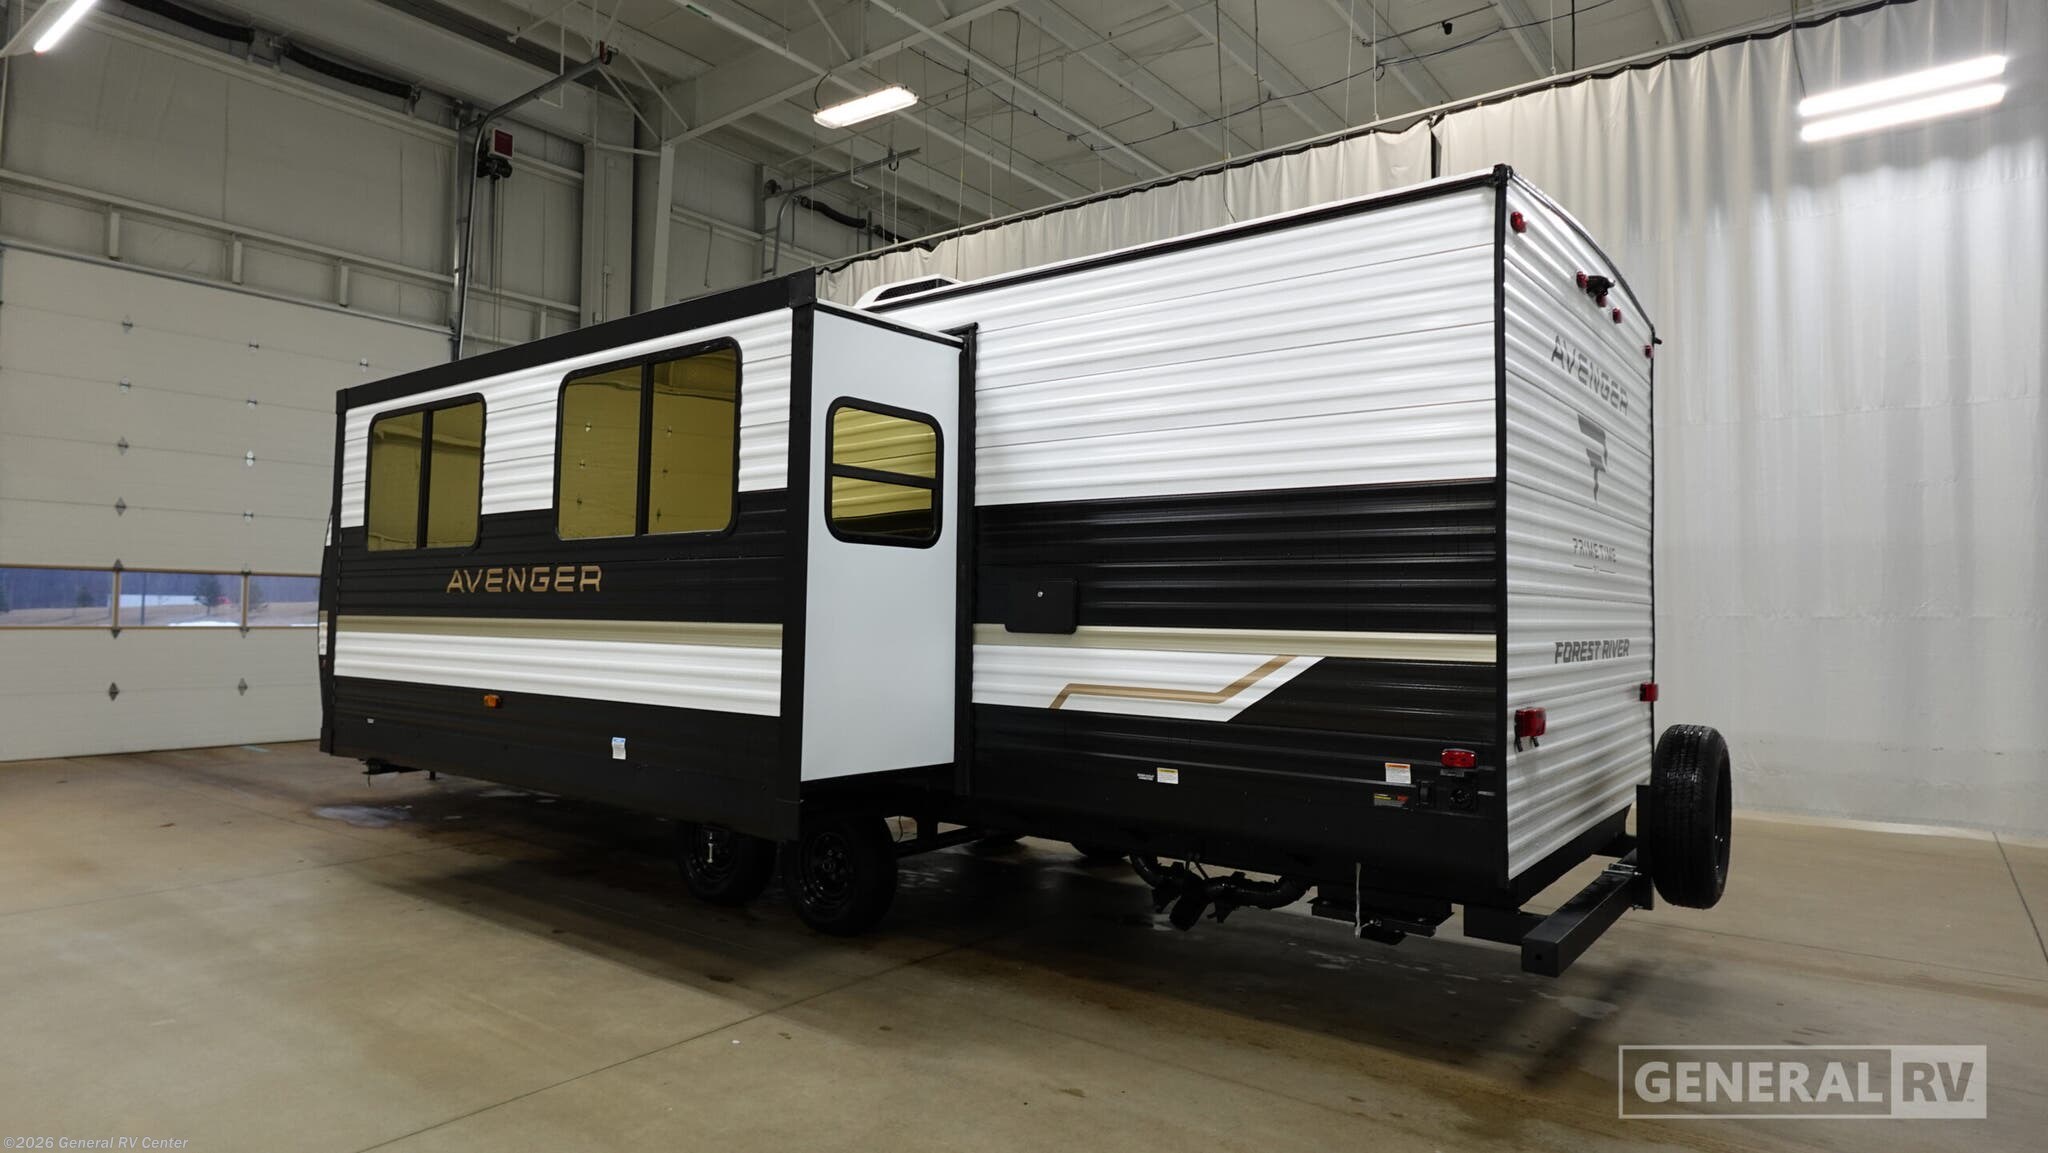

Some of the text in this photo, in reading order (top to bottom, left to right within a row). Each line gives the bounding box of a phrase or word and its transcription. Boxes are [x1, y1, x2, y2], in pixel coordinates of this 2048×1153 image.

[1551, 335, 1628, 416] AVENGER
[446, 565, 602, 593] AVENGER
[1554, 638, 1630, 664] FOREST RIVER
